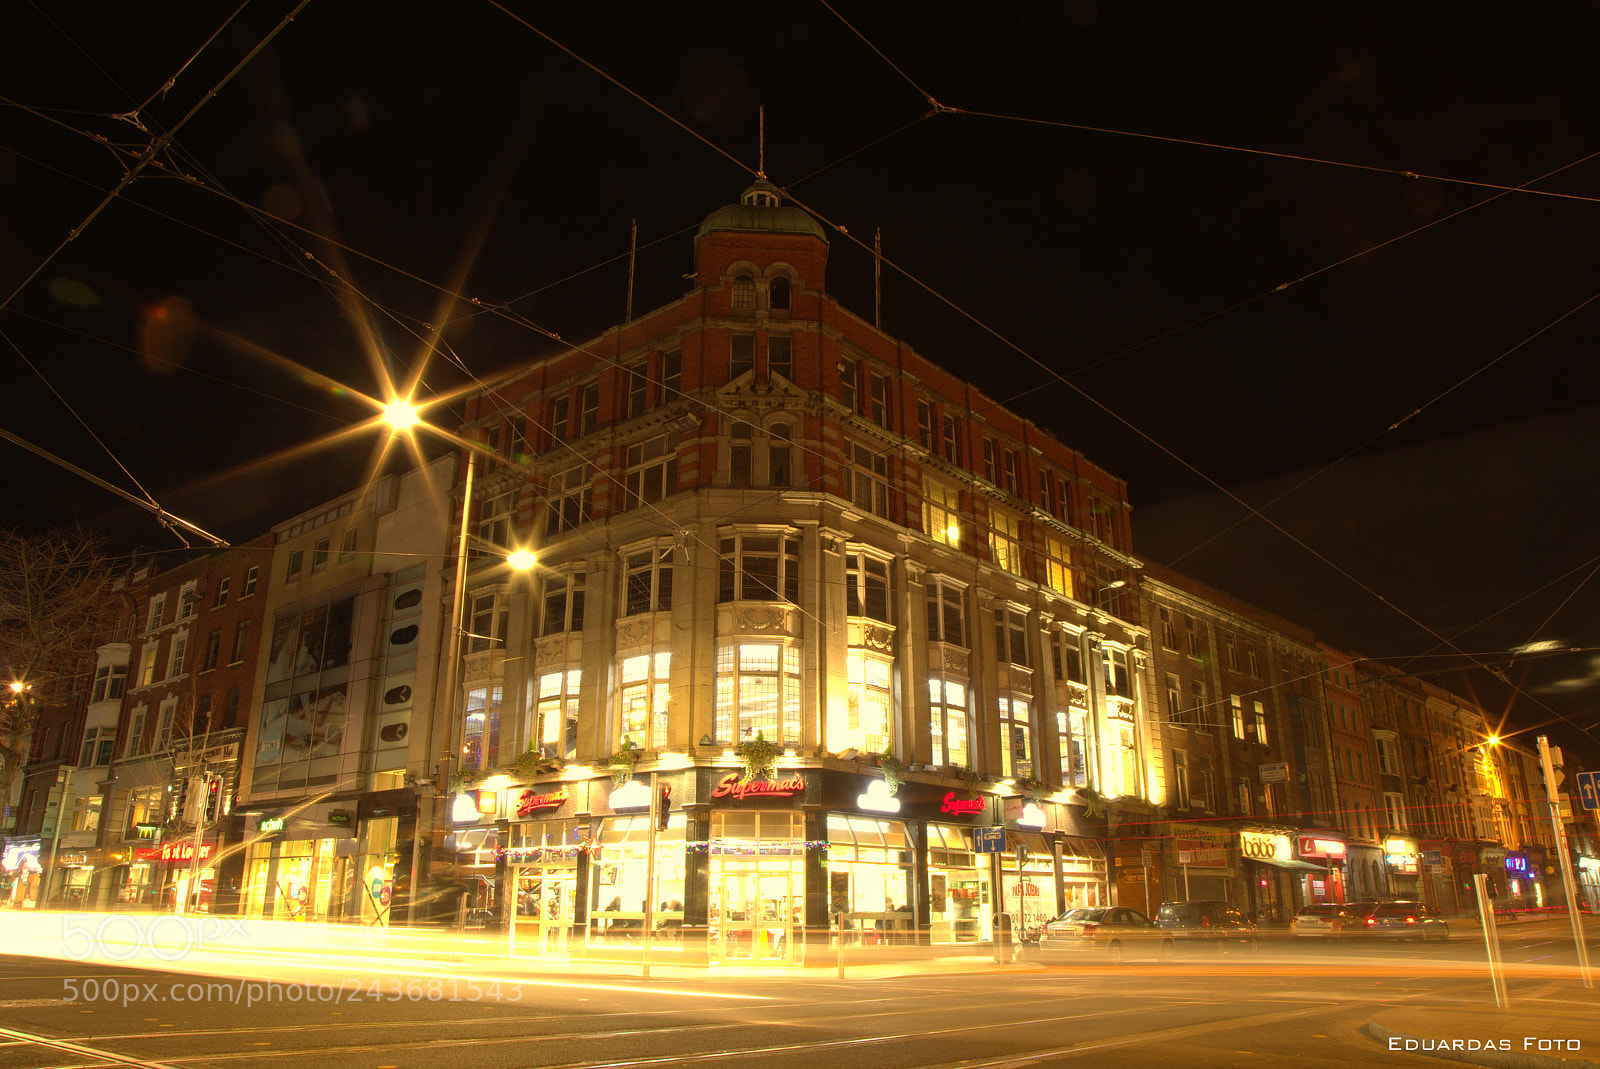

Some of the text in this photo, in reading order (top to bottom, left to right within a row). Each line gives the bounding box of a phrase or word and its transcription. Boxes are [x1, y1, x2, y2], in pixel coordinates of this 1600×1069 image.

[712, 772, 804, 800] Supermac's
[516, 785, 568, 814] Supermac's
[261, 817, 284, 832] schuh
[181, 842, 211, 860] Loer
